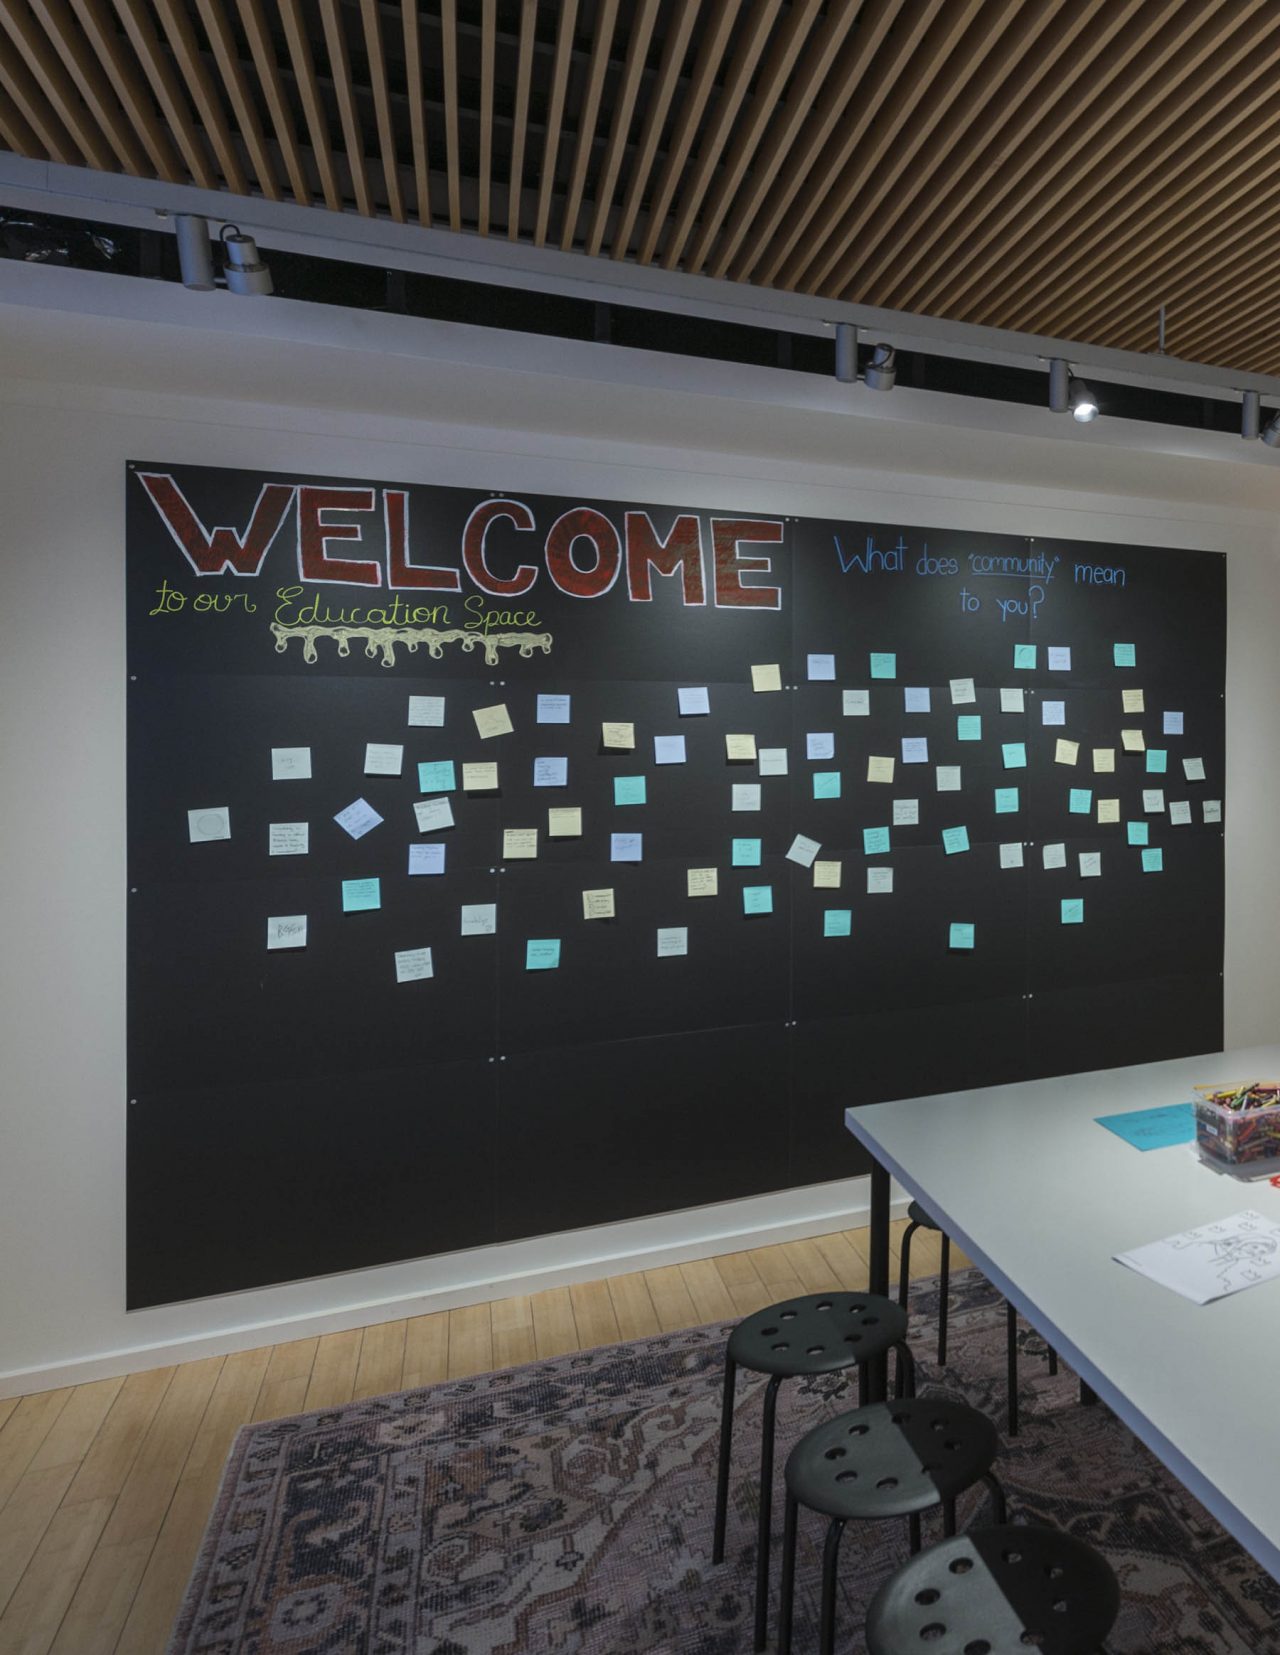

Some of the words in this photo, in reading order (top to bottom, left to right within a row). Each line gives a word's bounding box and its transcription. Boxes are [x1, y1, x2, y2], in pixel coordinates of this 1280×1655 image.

[134, 471, 785, 610] WELCOME
[833, 536, 909, 574] What
[916, 543, 960, 576] does
[1074, 562, 1127, 587] mean
[150, 579, 188, 616] to
[194, 593, 258, 612] our
[274, 586, 451, 628] Education
[464, 595, 543, 636] Space
[960, 587, 981, 613] to
[996, 584, 1046, 623] you?
